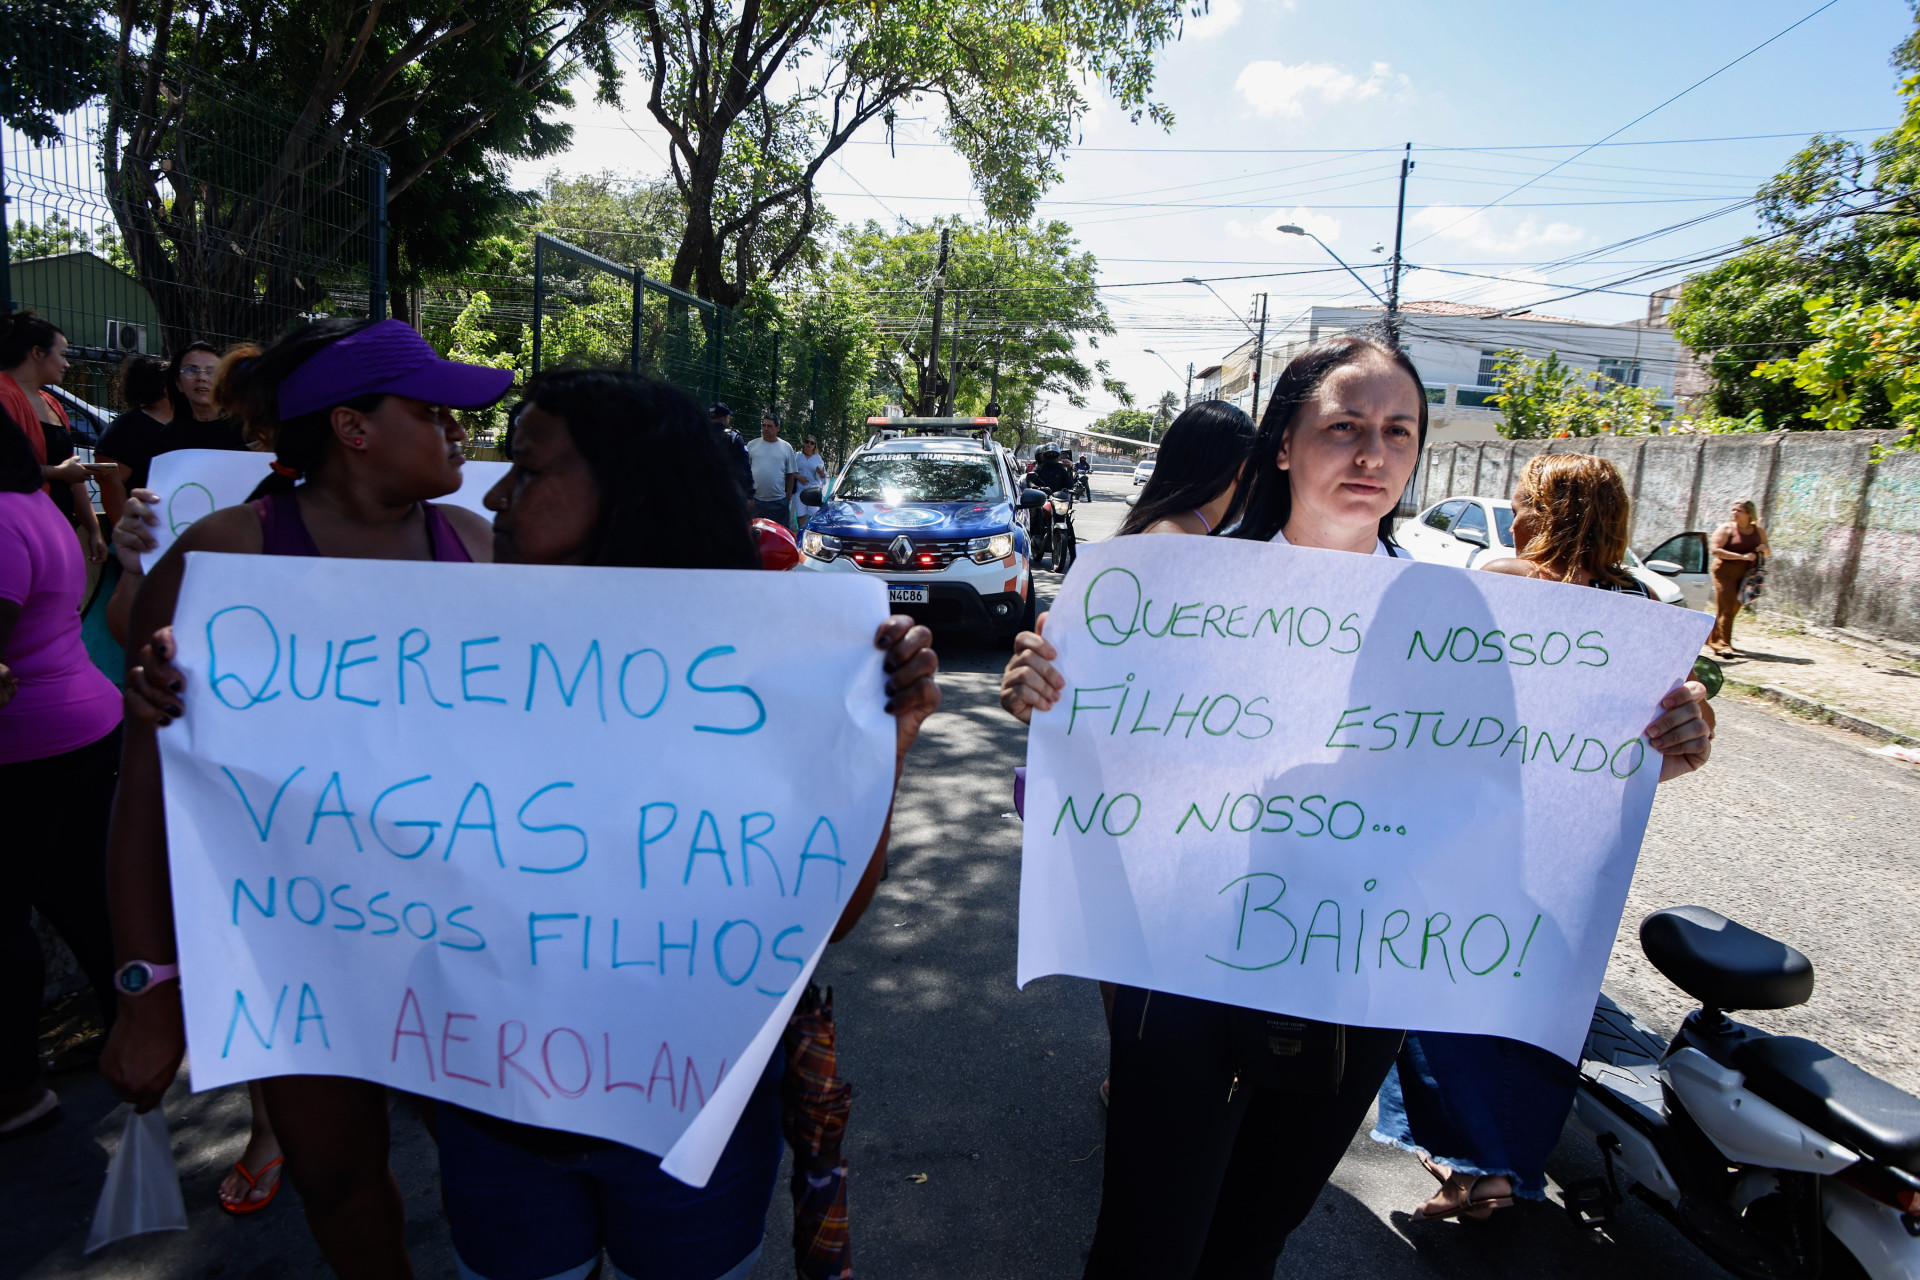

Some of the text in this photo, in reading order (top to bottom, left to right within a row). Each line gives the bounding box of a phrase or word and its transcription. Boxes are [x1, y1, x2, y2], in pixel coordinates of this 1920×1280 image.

[863, 453, 985, 463] GUARDA MUNICIPAL
[206, 605, 767, 735] QUEREMOS
[1084, 567, 1610, 668] QUEREMOS NOSSOS
[1325, 705, 1645, 779] ESTUDANDO
[220, 765, 847, 897] VAGAS PARA
[1052, 792, 1407, 840] NO NOSSO...
[231, 875, 804, 996] NOSSOS FILHOS
[220, 983, 728, 1113] NA AEROLAN
